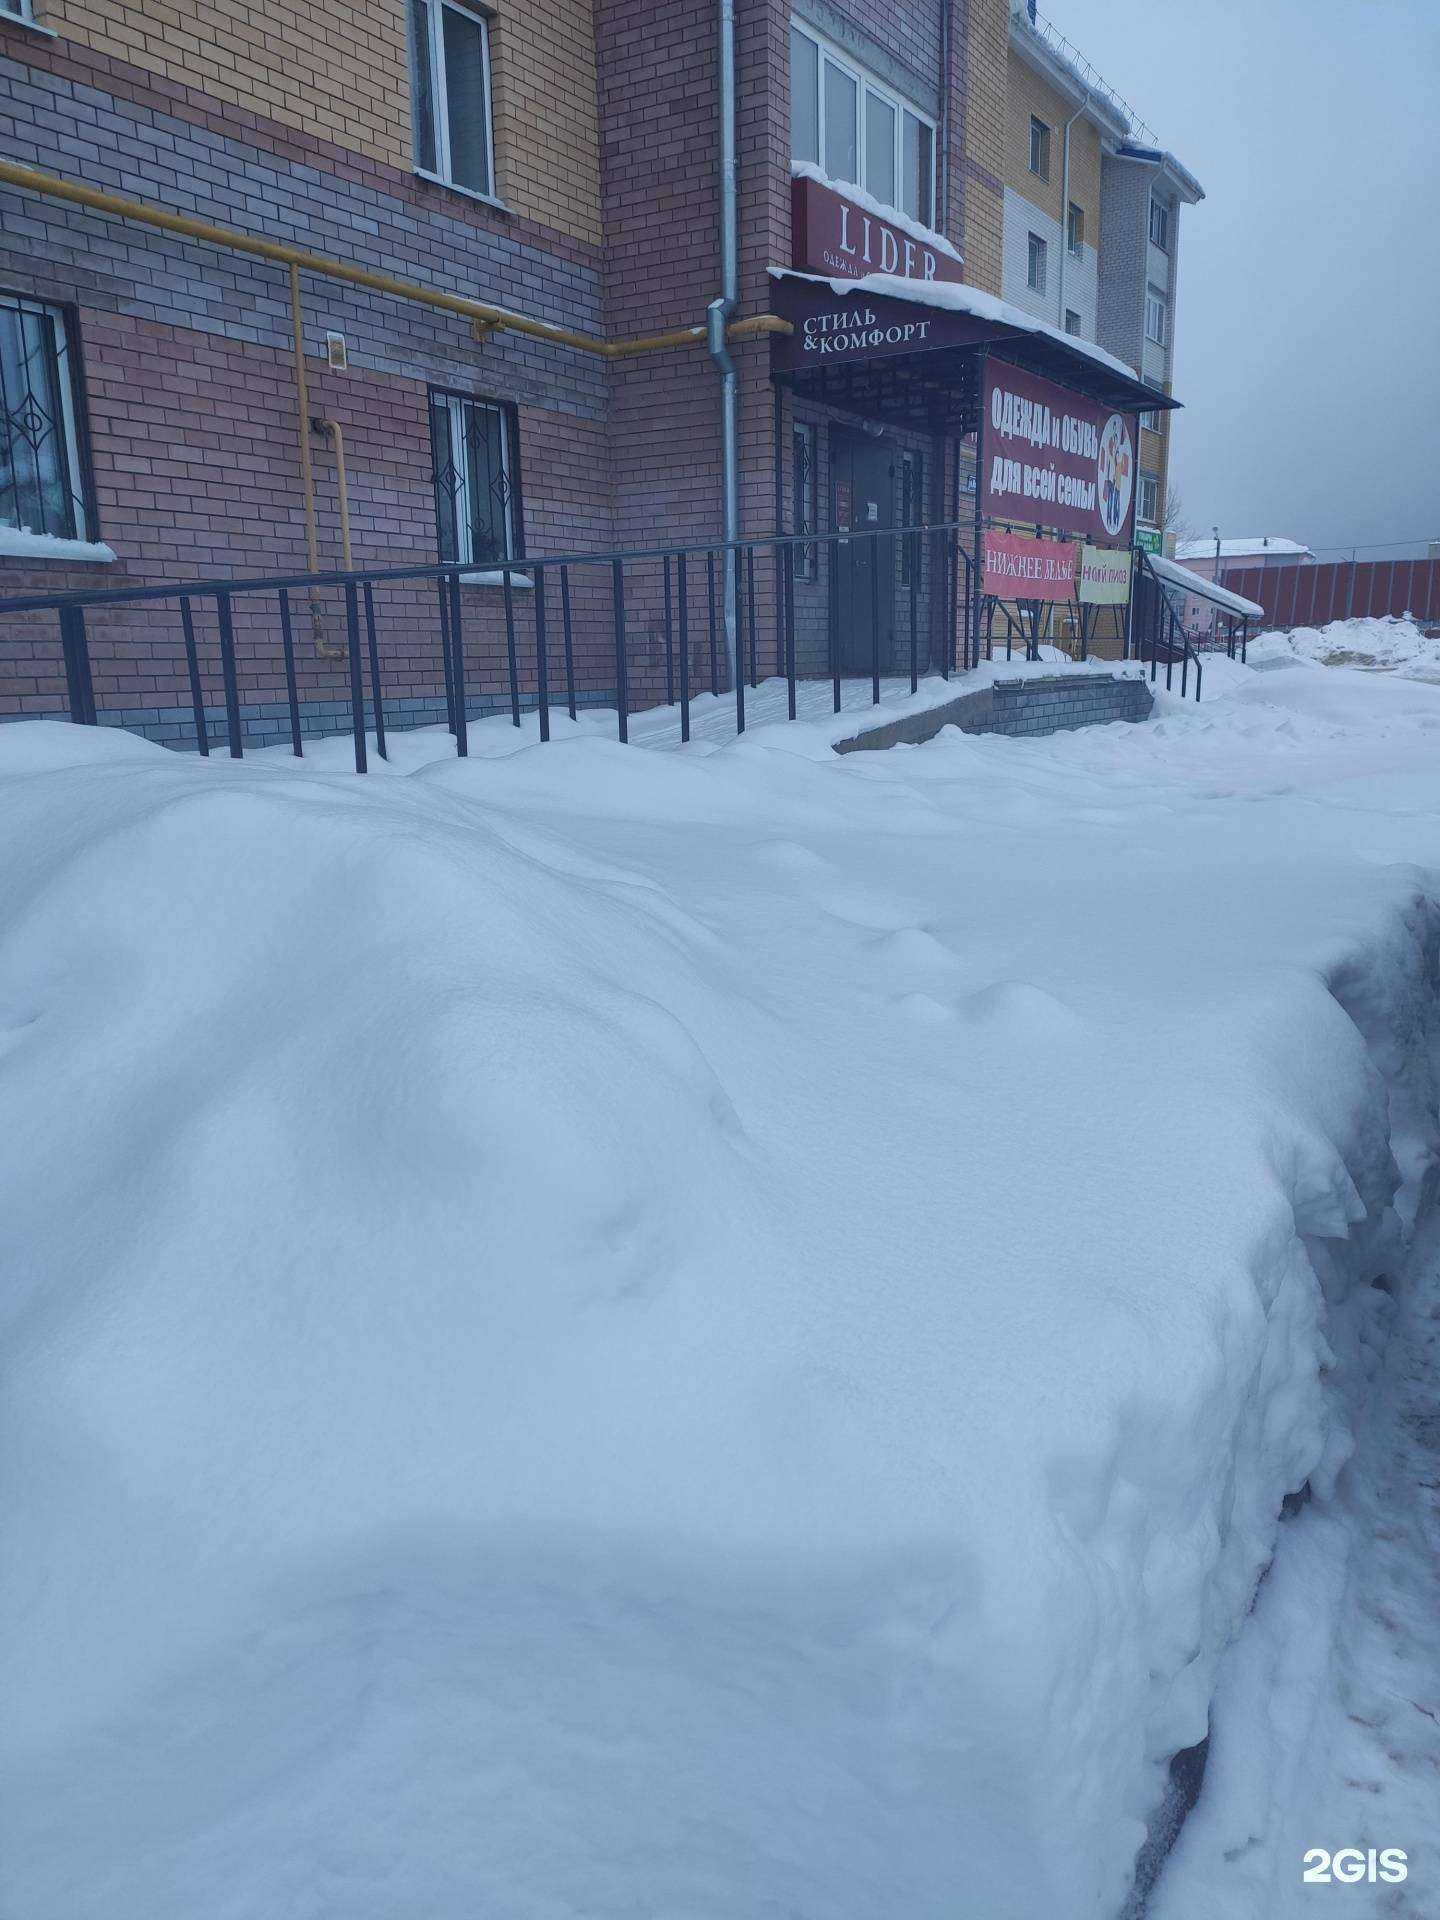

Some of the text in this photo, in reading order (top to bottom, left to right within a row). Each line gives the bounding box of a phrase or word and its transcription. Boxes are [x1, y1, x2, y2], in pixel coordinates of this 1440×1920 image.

[840, 205, 936, 280] LIDER
[823, 250, 858, 277] ОДЕЖДА
[803, 308, 876, 334] СТИЛЬ
[803, 321, 930, 354] &КОМФОРТ
[991, 387, 1050, 449] ОДЕЖДА
[1062, 414, 1098, 460] ОБУВЬ
[985, 549, 1043, 580] НИЖНЕЕ
